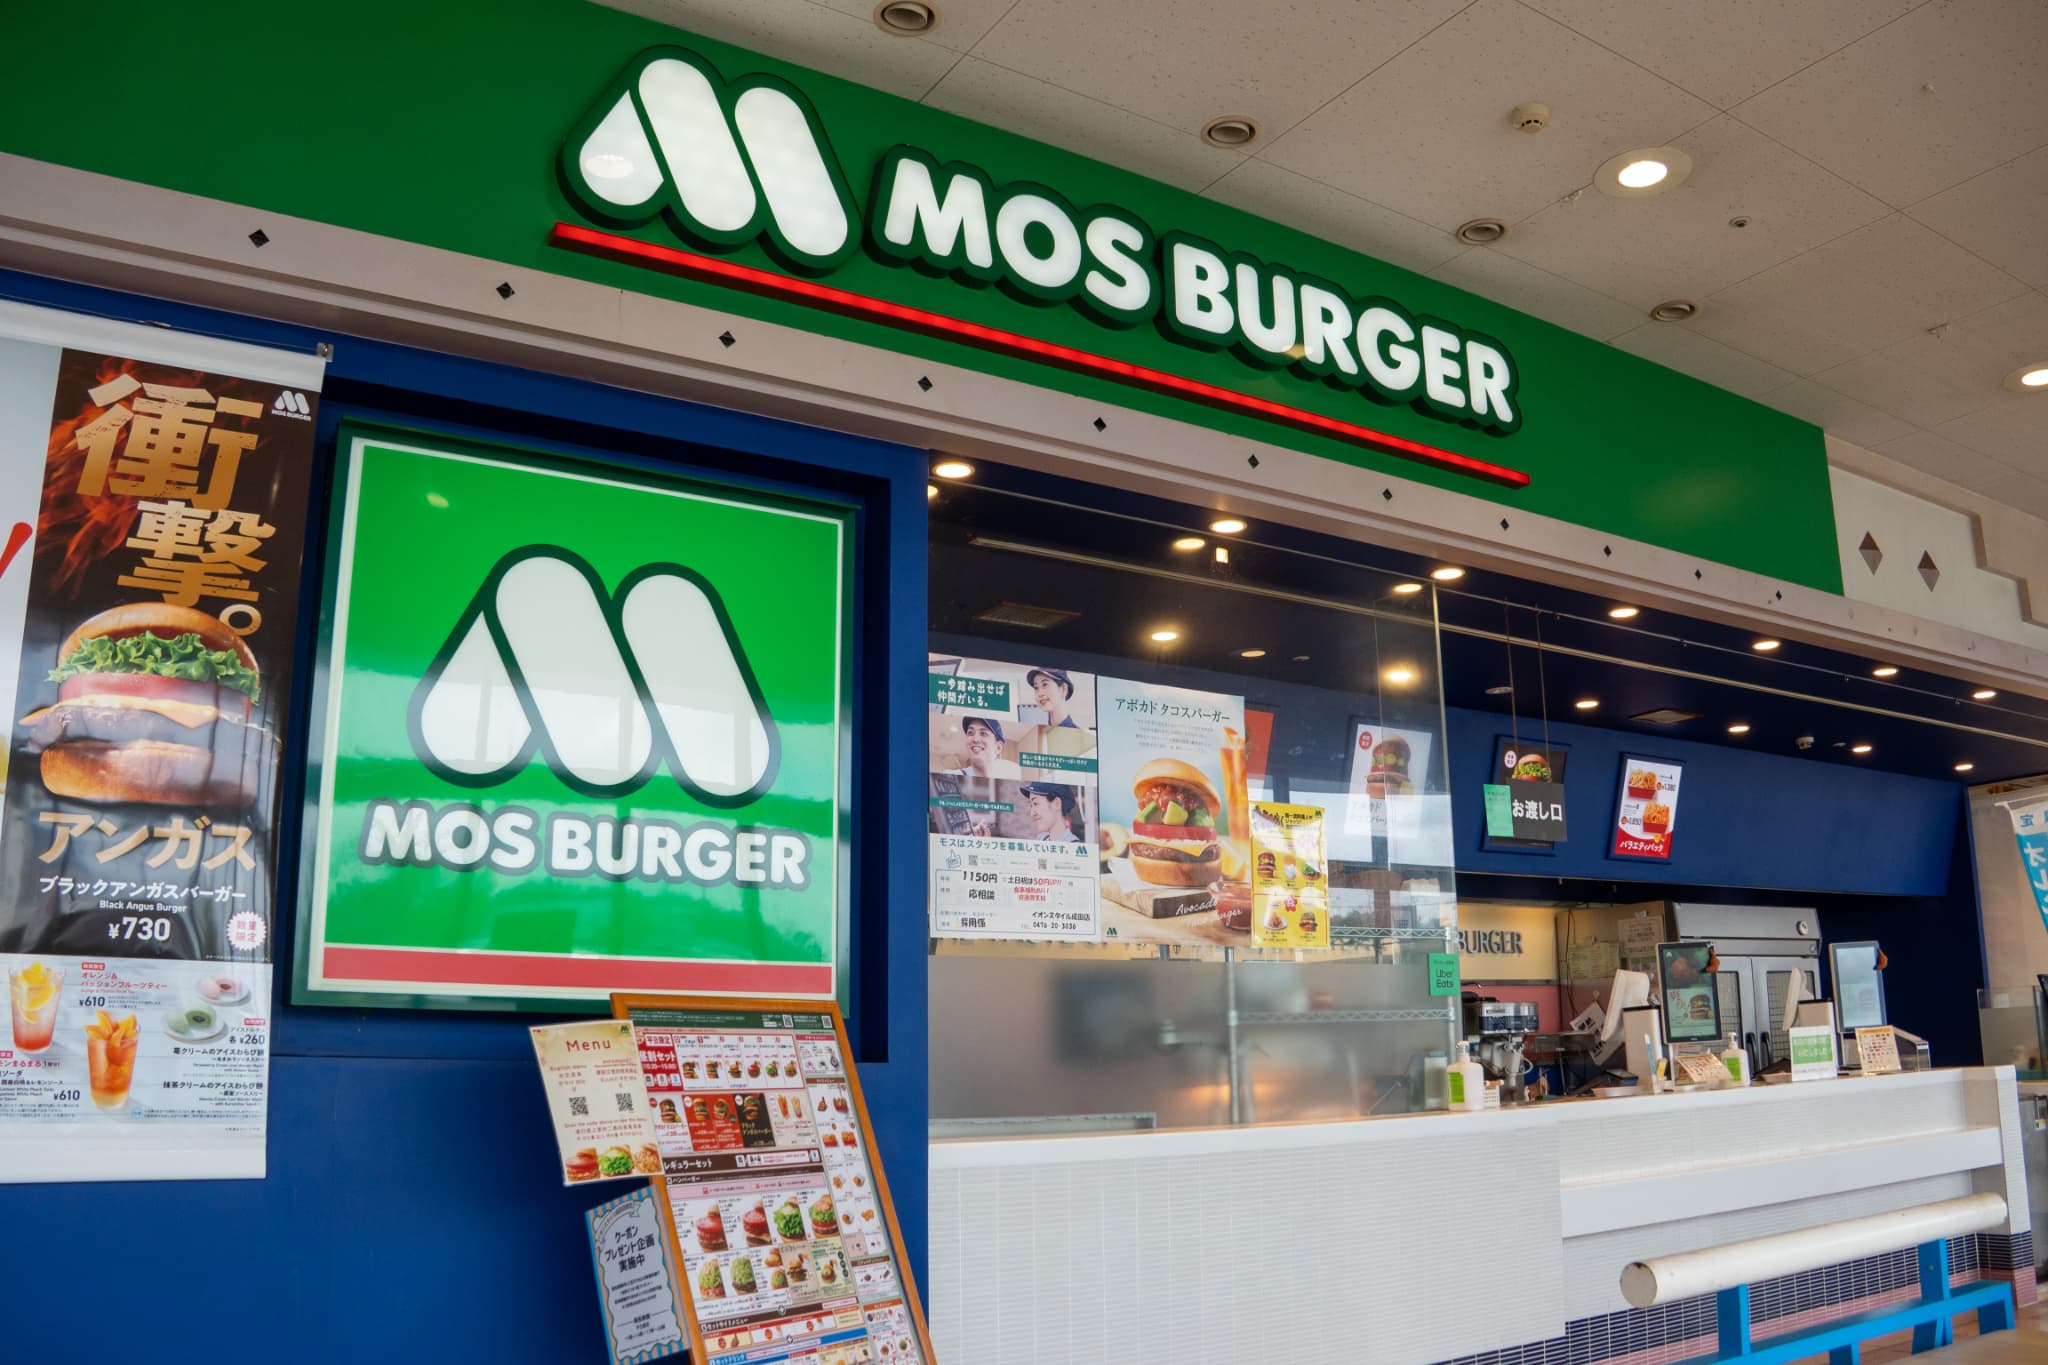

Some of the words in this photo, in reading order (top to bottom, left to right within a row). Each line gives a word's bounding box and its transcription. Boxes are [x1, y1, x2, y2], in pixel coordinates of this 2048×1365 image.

[883, 157, 1151, 312] MOS
[1173, 242, 1513, 425] BURGER
[937, 678, 1006, 696] 一歩踏み出せば
[937, 690, 989, 708] 仲間がいる。
[1512, 799, 1564, 822] お渡し口
[38, 811, 257, 872] アンガス
[365, 804, 535, 868] MOS
[551, 818, 807, 884] BURGER
[939, 837, 1070, 855] モスはスタッフを募集しています。
[1619, 840, 1664, 853] バラエティパック
[962, 871, 998, 884] 1150円
[39, 876, 247, 903] ブラックアンガスバーガー
[968, 889, 995, 901] 応相談
[99, 900, 125, 910] Black
[126, 901, 155, 913] Angus
[156, 903, 188, 914] Burger
[108, 916, 171, 942] ¥730
[1435, 968, 1453, 978] Uber
[1435, 979, 1455, 989] Eats
[565, 1038, 612, 1052] Menu
[53, 1089, 81, 1101] ¥610
[614, 1225, 639, 1243] クーポン
[604, 1233, 655, 1263] プレゼント企画
[618, 1253, 646, 1274] 実施中
